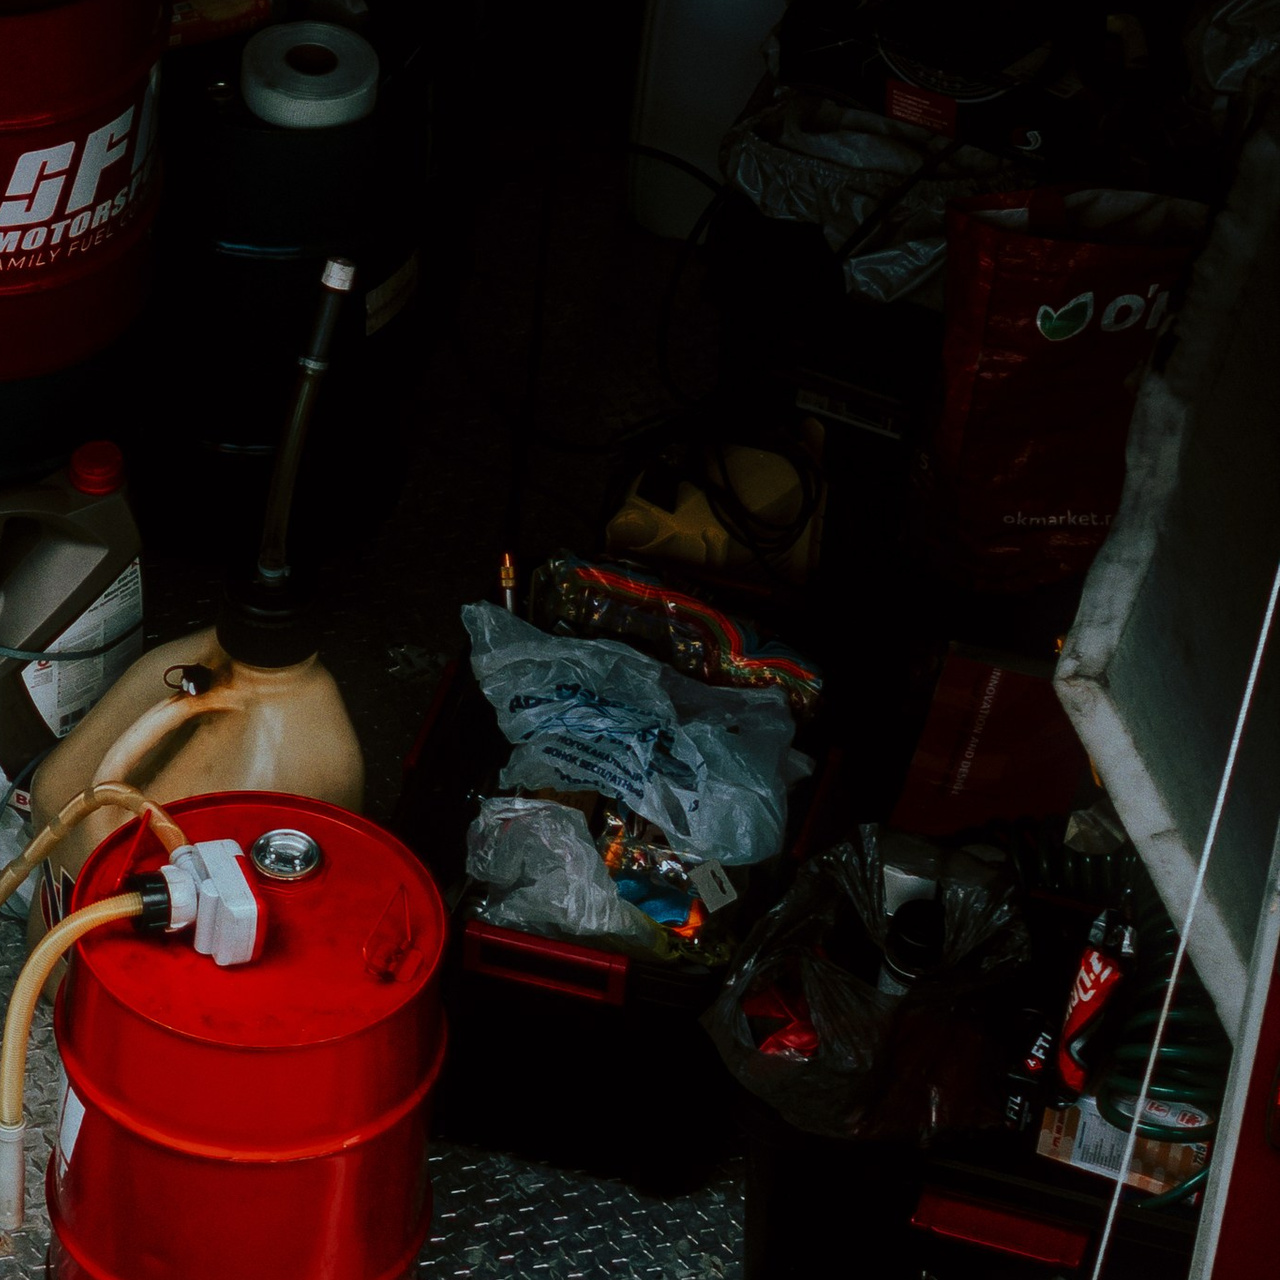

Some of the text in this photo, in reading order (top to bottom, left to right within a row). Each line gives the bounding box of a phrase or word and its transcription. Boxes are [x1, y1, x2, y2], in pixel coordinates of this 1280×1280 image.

[67, 228, 114, 257] FUEL
[1003, 510, 1112, 527] okmarket.r
[973, 667, 1001, 734] INNOVATION
[964, 736, 979, 758] AND
